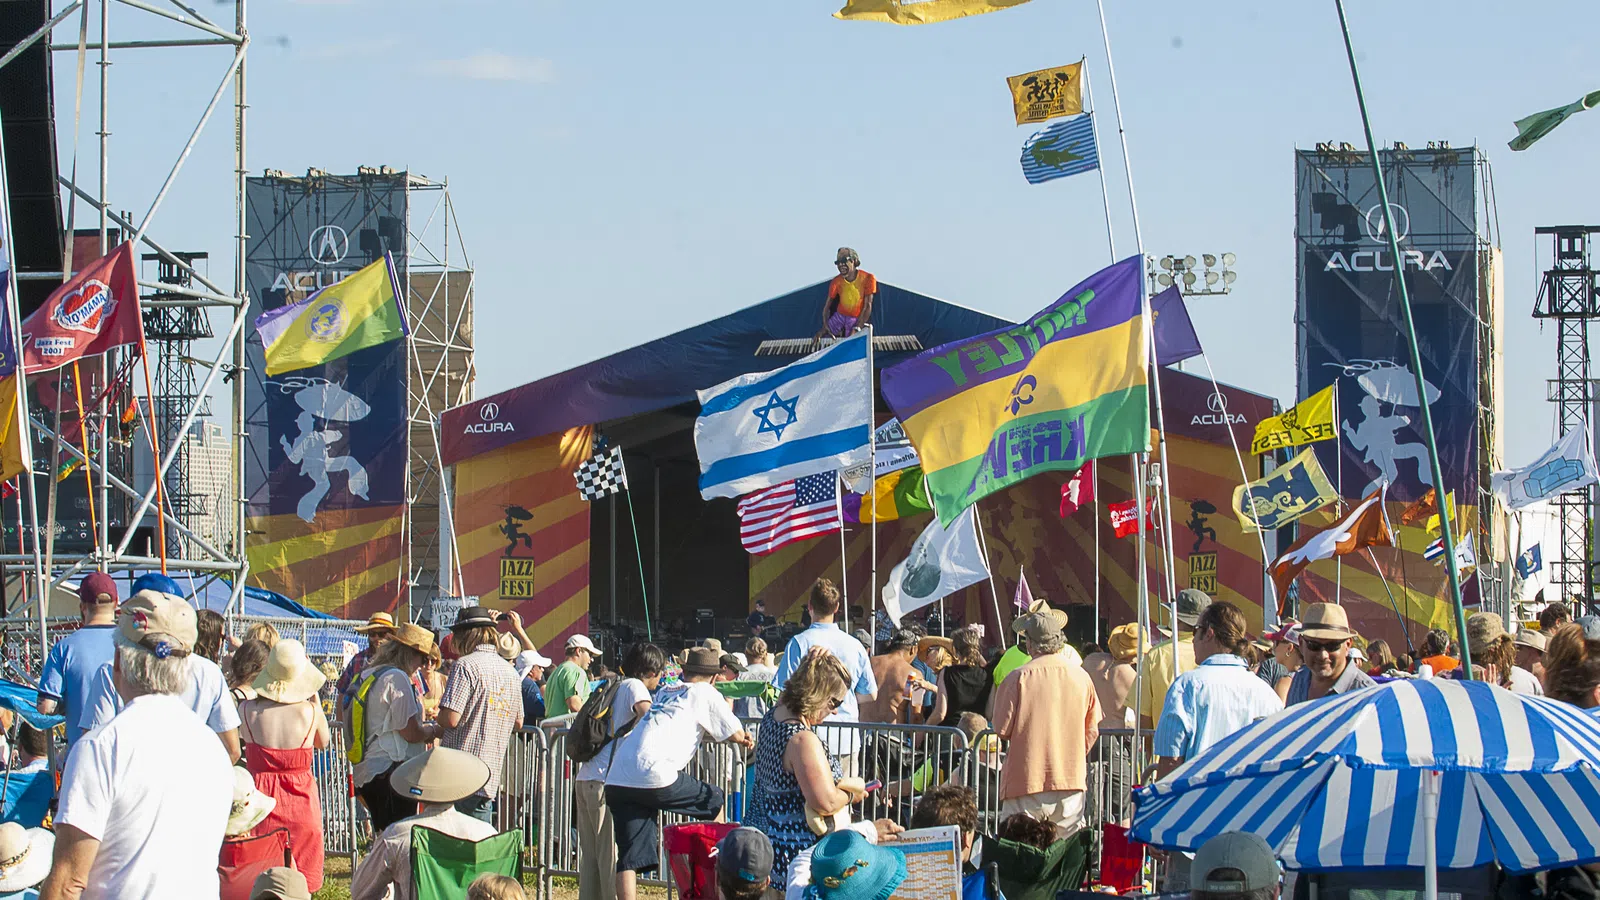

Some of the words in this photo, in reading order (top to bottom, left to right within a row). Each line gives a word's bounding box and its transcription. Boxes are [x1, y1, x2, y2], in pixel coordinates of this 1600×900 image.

[1324, 250, 1452, 271] ACURA
[270, 271, 356, 292] ACU
[36, 339, 53, 347] Jazz
[54, 338, 72, 346] Fest
[1190, 413, 1248, 425] ACURA
[464, 422, 514, 434] ACURA
[501, 560, 533, 577] JAZZ
[1190, 555, 1216, 574] JAZZ
[501, 580, 534, 596] FEST
[1190, 575, 1217, 591] FEST
